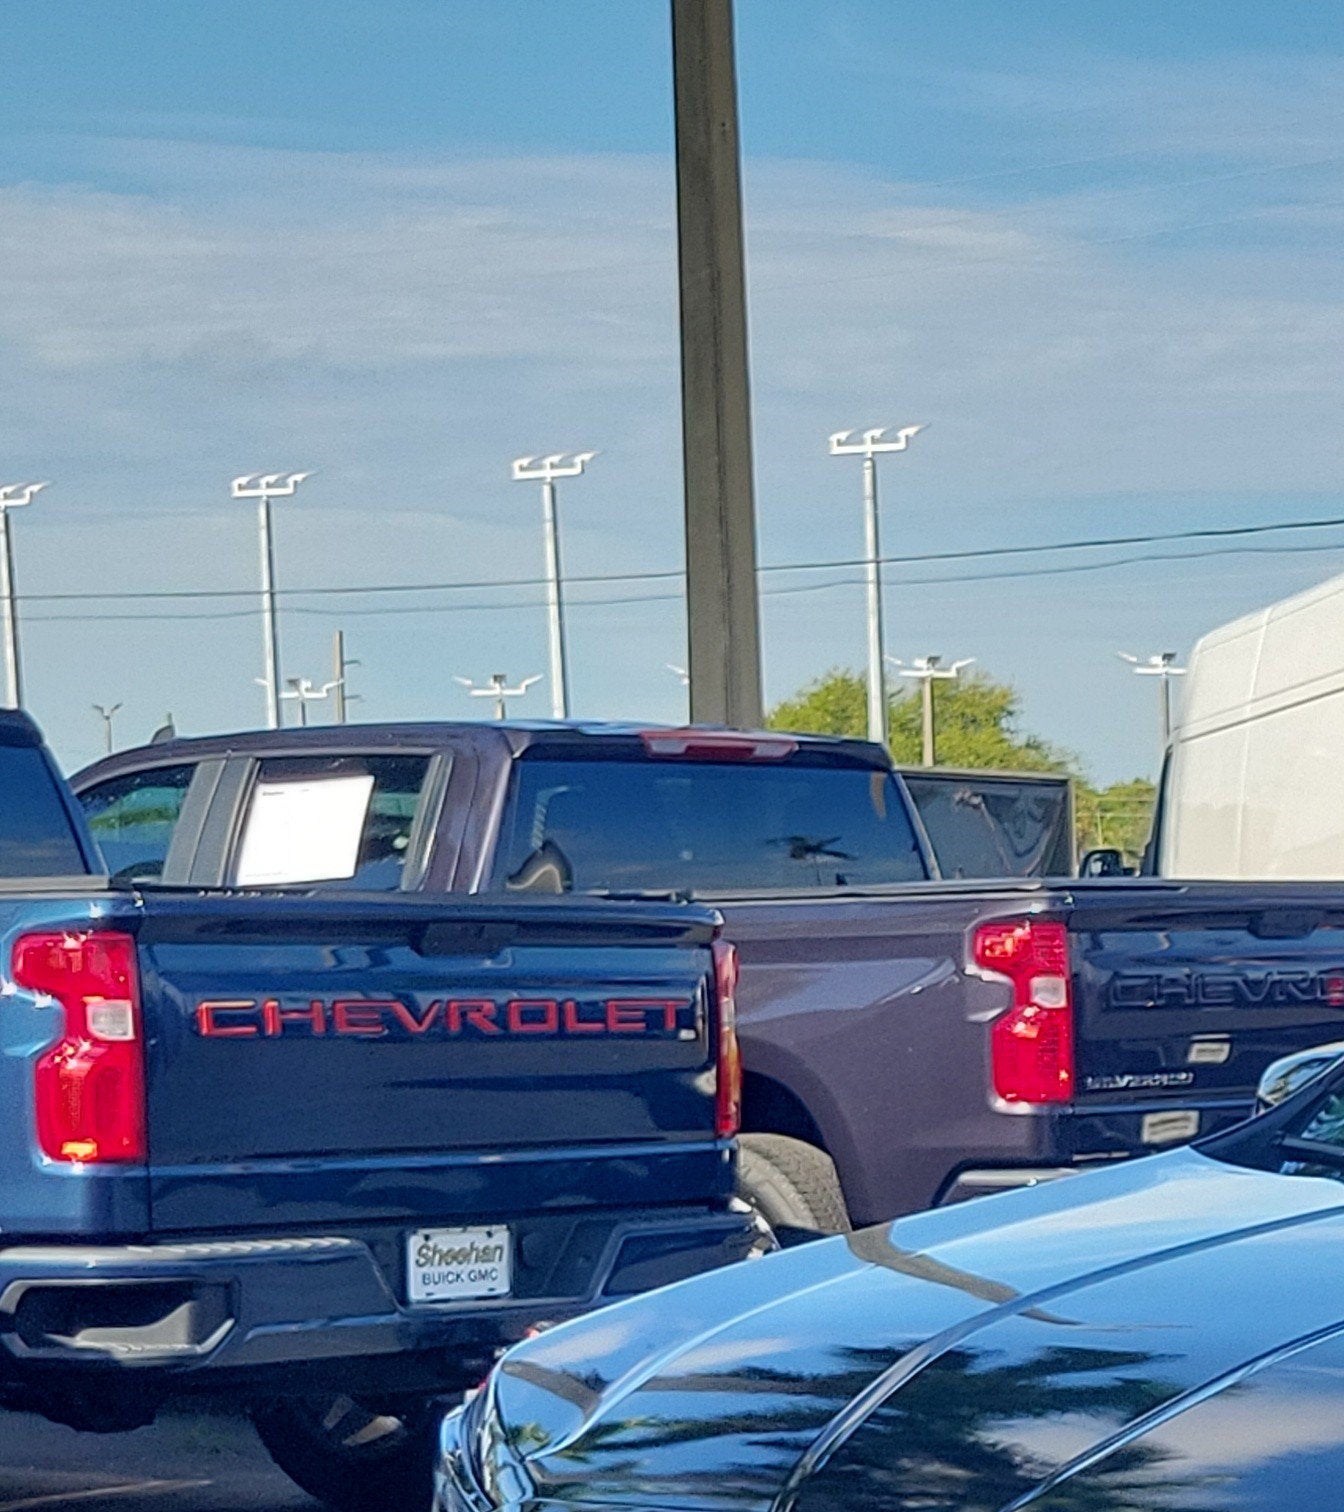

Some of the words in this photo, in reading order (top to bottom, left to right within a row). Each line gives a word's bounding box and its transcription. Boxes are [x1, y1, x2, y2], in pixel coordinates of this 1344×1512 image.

[195, 998, 693, 1038] CHEVROLET
[415, 1241, 504, 1268] Sheehan
[422, 1270, 465, 1286] BUICK
[468, 1267, 499, 1283] GMC
